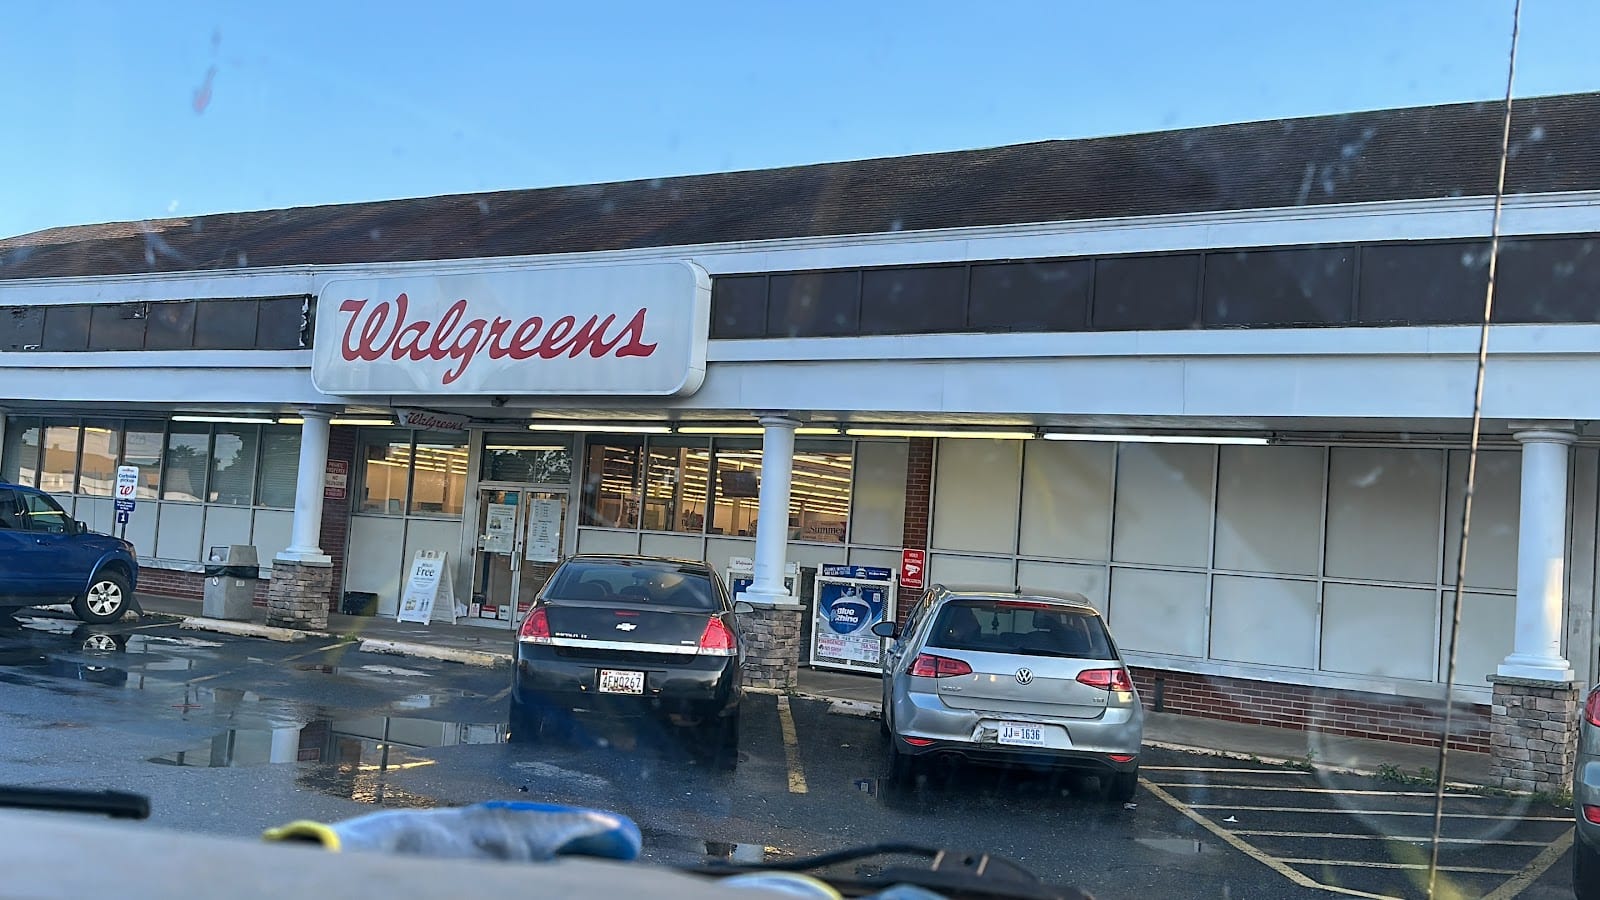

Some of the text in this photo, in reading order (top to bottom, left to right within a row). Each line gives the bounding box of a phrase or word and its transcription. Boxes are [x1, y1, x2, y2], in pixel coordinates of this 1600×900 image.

[338, 292, 658, 385] Walgreens
[408, 411, 464, 430] Walgreens
[809, 525, 843, 535] Summer
[416, 566, 435, 577] Free
[837, 607, 855, 616] Blue
[1003, 727, 1040, 741] JJ 1636
